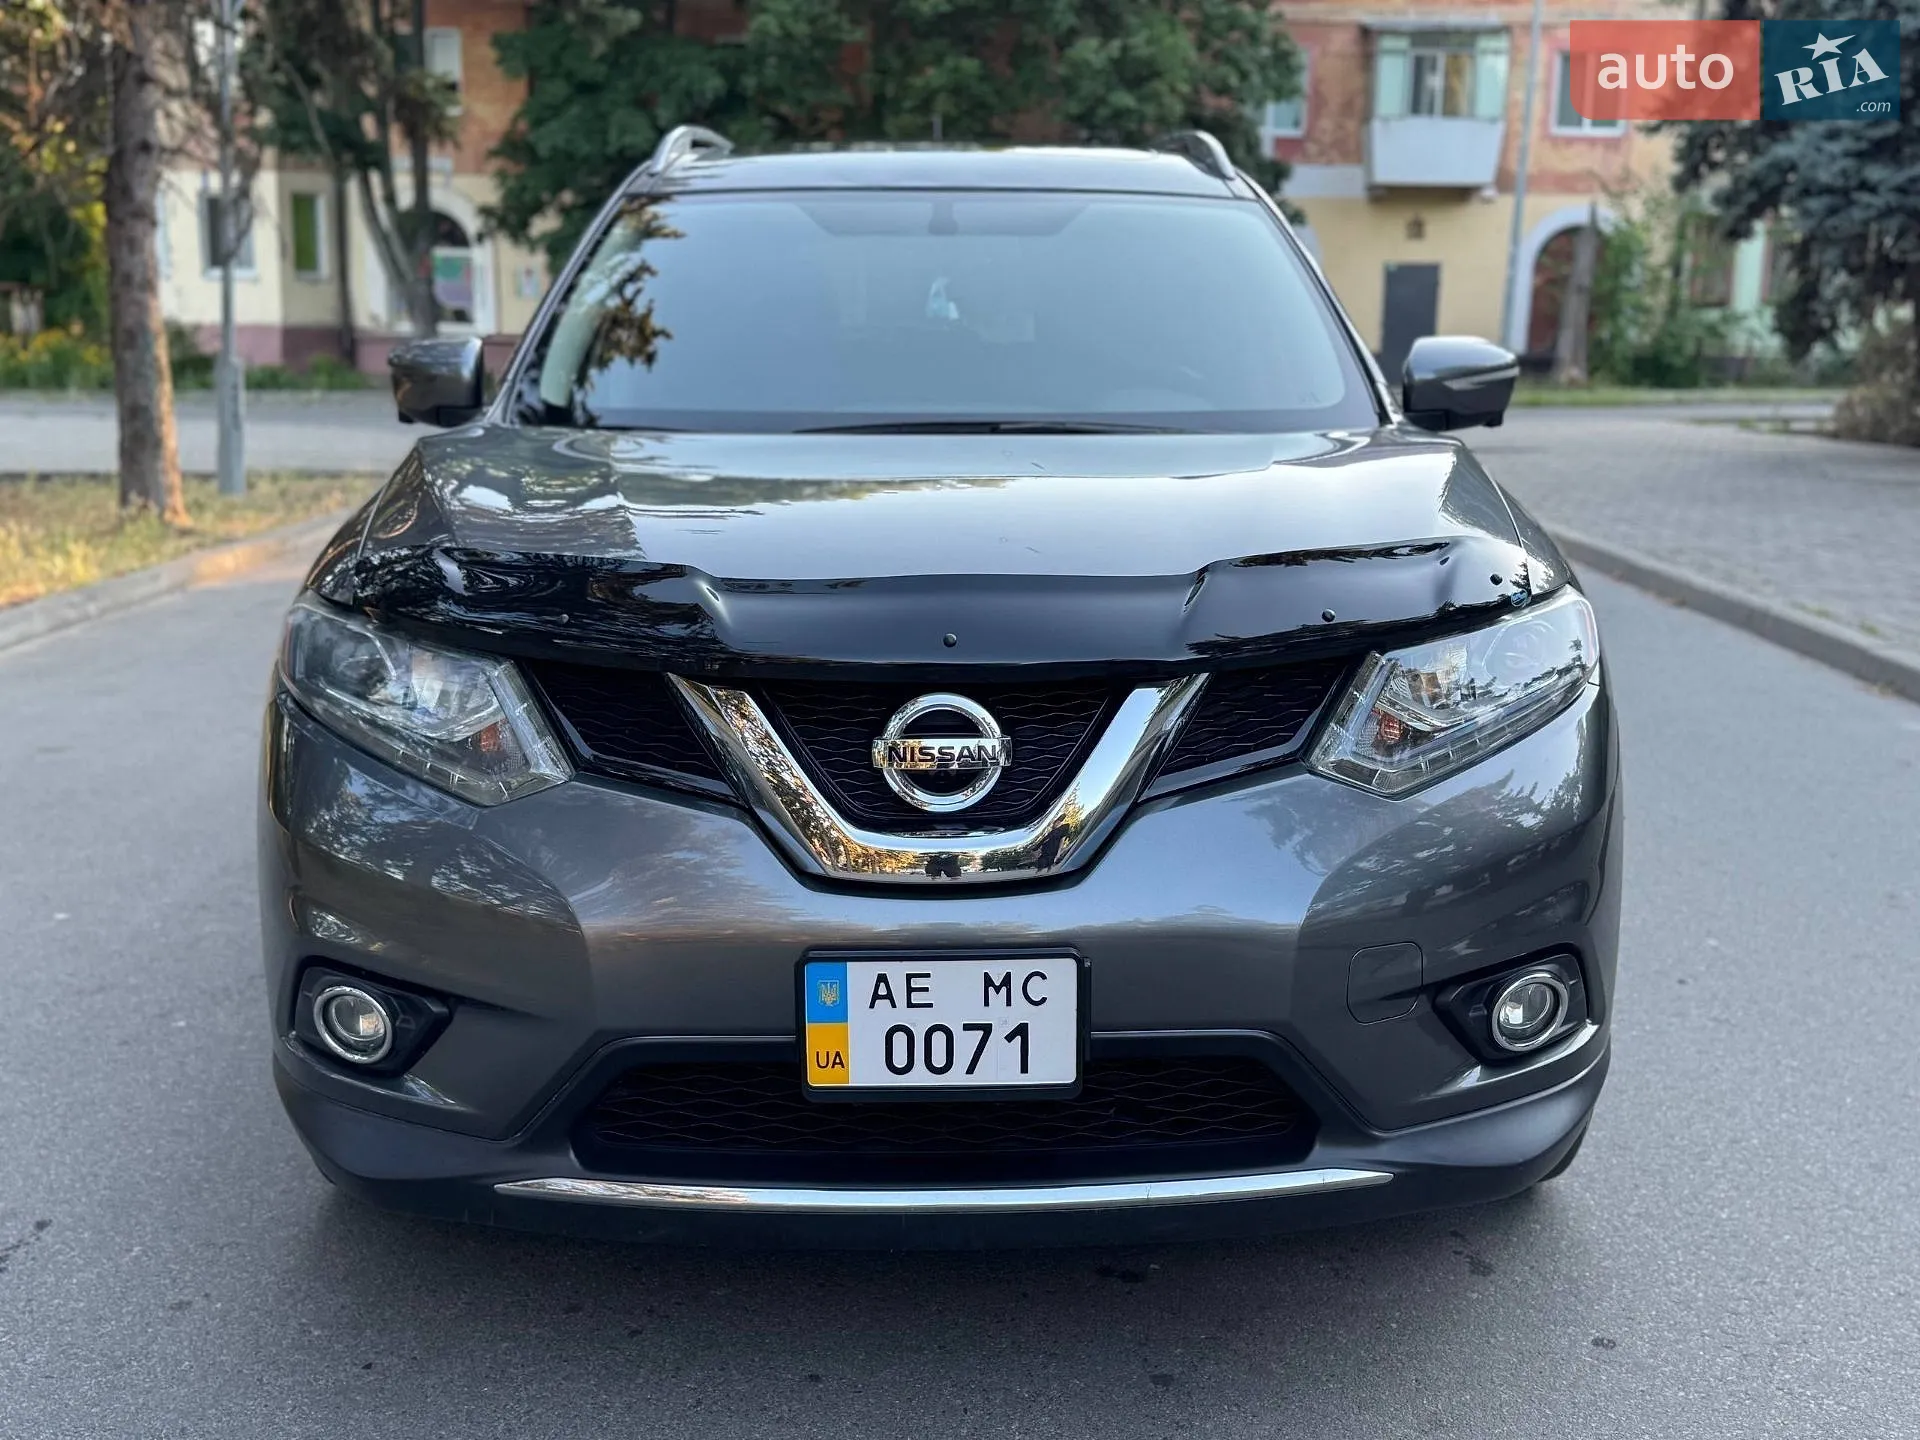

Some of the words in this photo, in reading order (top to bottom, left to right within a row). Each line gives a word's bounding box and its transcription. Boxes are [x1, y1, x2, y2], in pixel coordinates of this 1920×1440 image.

[887, 745, 998, 763] NISSAN
[868, 972, 934, 1009] AE
[983, 970, 1048, 1007] MC
[815, 1050, 845, 1070] UA
[884, 1022, 1029, 1076] 0071
